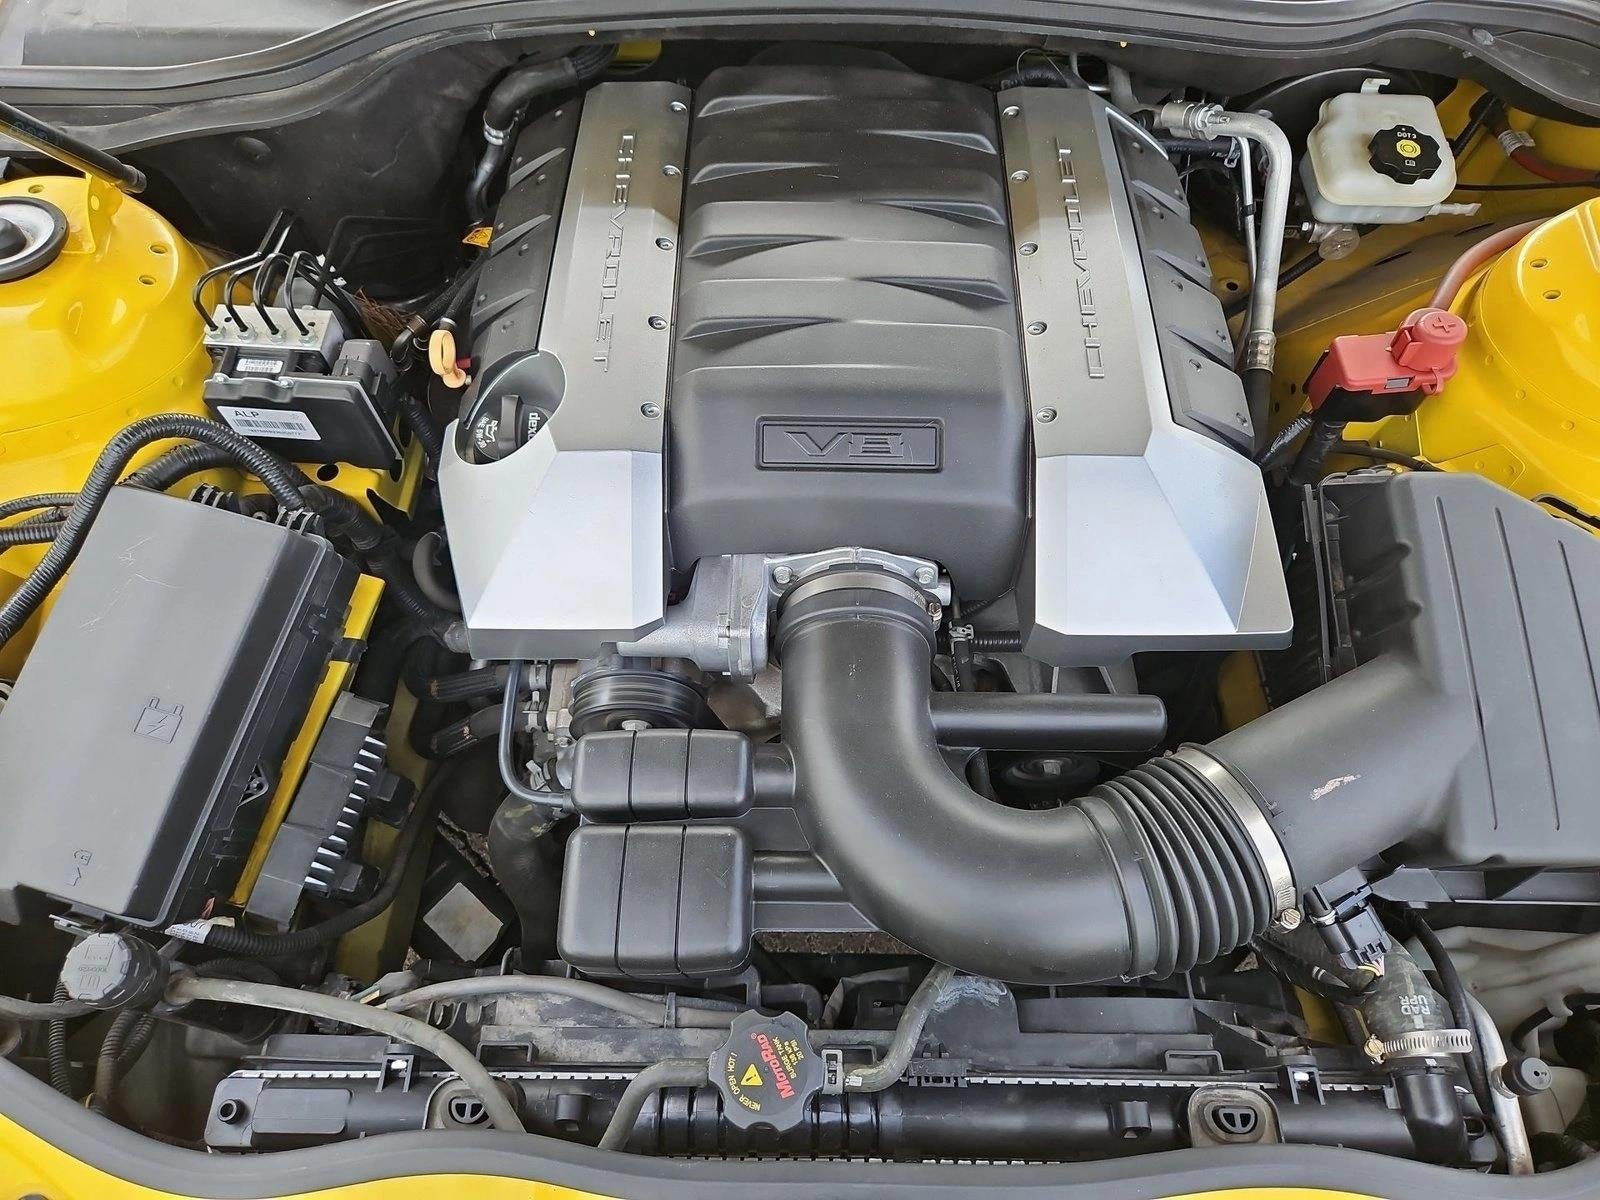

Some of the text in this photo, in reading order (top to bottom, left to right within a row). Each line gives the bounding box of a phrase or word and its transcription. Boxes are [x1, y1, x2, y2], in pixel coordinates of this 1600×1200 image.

[592, 129, 637, 373] CHEVROLET
[1054, 137, 1105, 379] CHEVROLET
[234, 409, 260, 418] ALP
[784, 430, 904, 457] V8
[1398, 994, 1428, 1006] UPR
[1401, 1004, 1431, 1015] RAD
[773, 1037, 796, 1079] SURGE TANK
[790, 1039, 804, 1060] 20 PSI
[727, 1052, 761, 1111] NEVER OPEN HOT!
